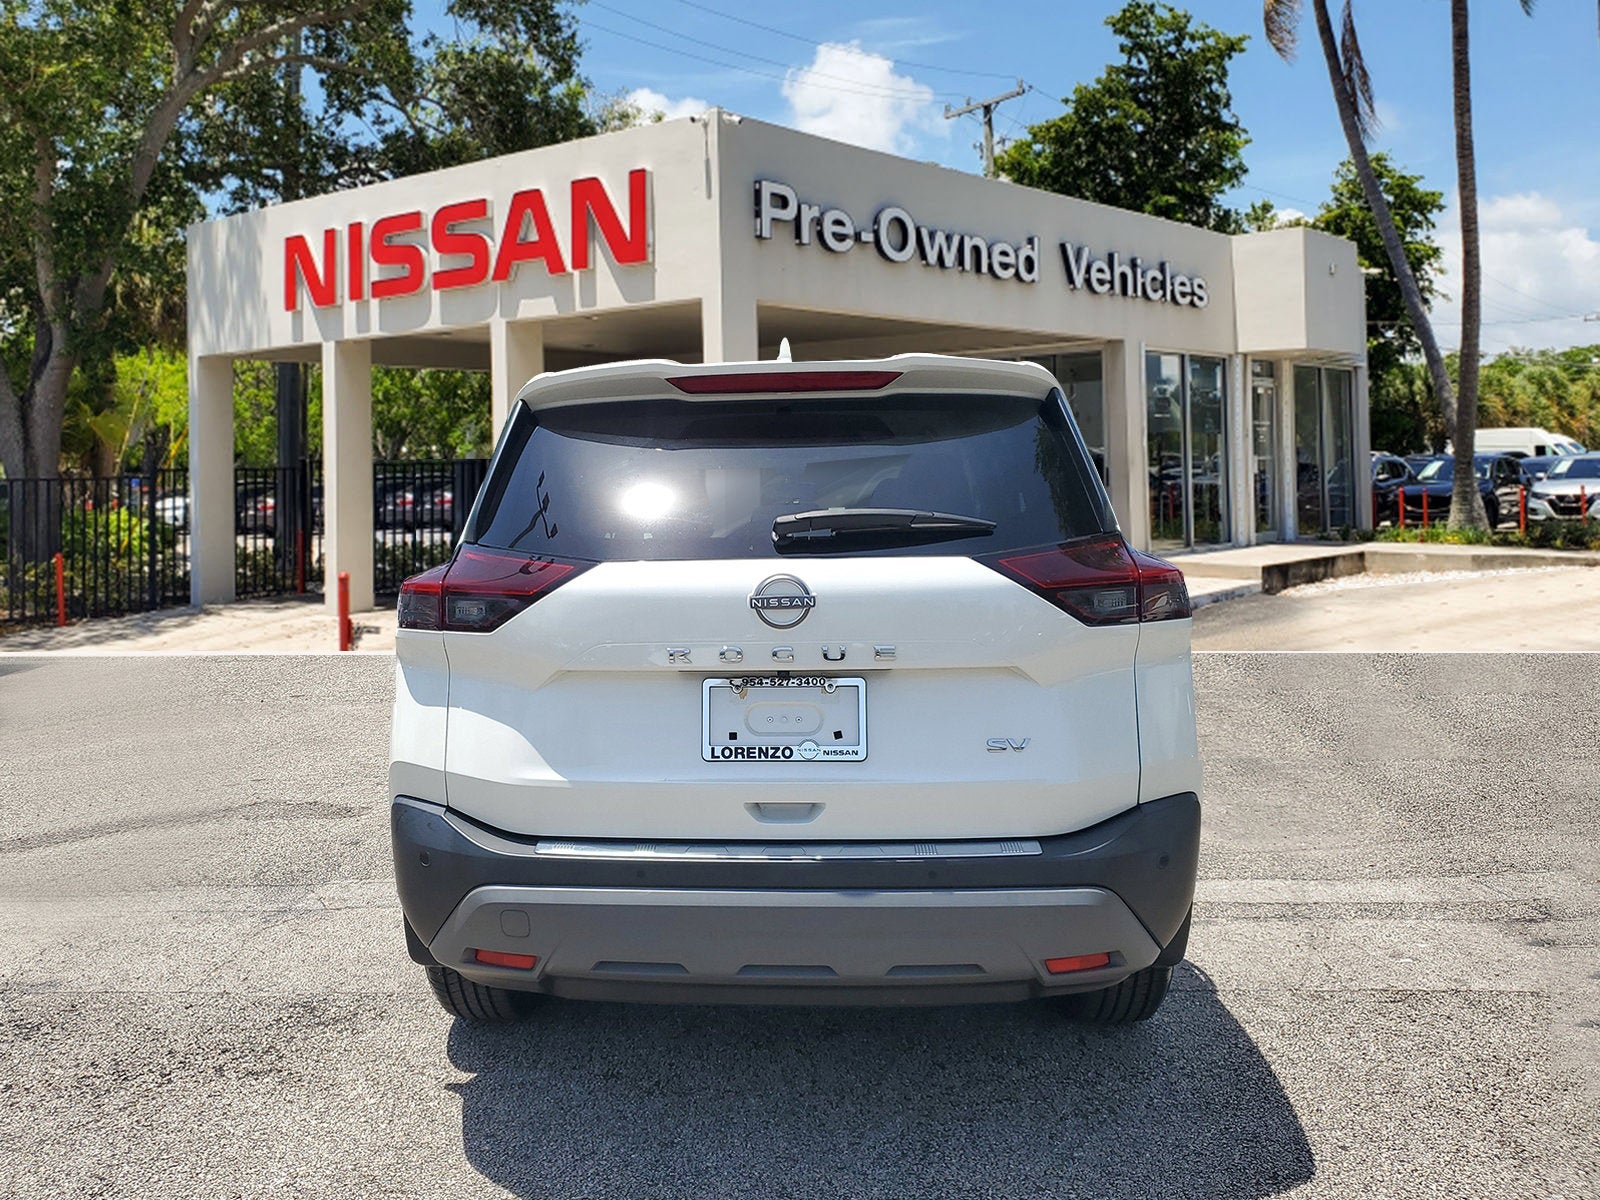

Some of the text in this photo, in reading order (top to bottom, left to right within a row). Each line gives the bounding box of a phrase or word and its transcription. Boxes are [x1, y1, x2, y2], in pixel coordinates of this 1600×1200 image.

[284, 168, 649, 312] NISSAN
[754, 179, 1209, 309] Pre-Owned Vehicles
[751, 596, 815, 609] NISSAN
[666, 645, 898, 664] ROGUE
[741, 676, 826, 688] 954-527-3400
[710, 746, 794, 760] LORENZO
[986, 737, 1032, 754] SV
